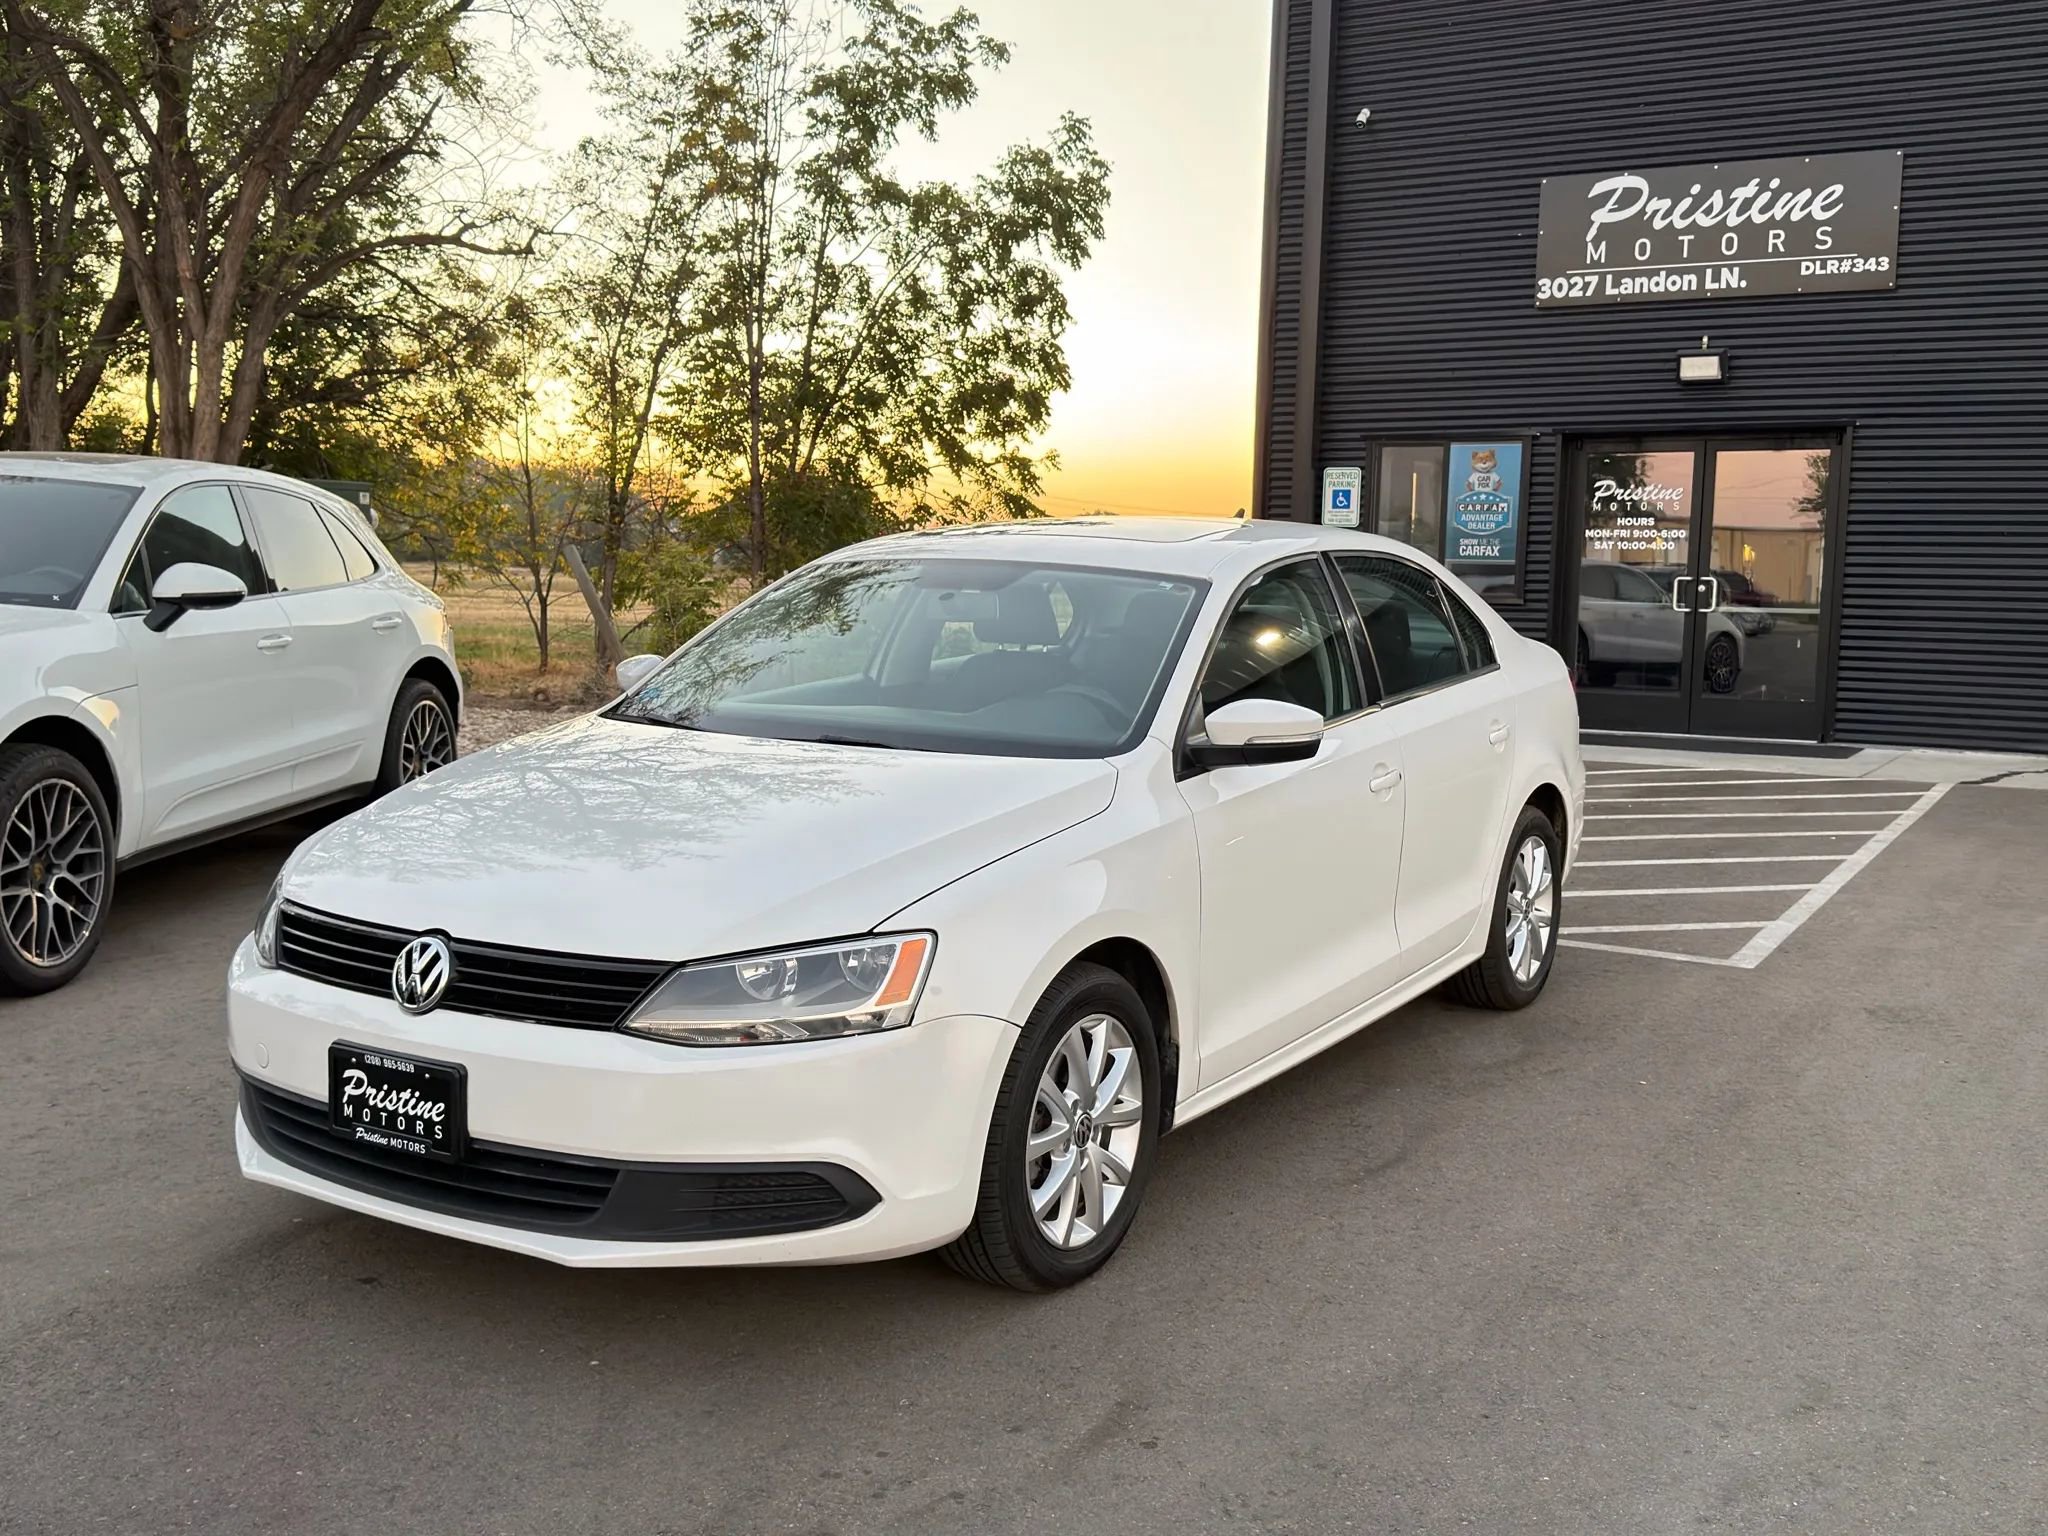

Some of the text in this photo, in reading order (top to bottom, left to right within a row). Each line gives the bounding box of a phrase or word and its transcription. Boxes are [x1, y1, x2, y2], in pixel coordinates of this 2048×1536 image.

[1586, 174, 1845, 242] Pristine
[1585, 226, 1833, 265] MOTORS
[1800, 256, 1890, 277] DLR#343
[1536, 266, 1748, 299] 3027 Landon LN.
[1328, 480, 1356, 488] PARKING
[1593, 479, 1684, 504] Pristine
[1459, 503, 1508, 512] CARFAX
[1593, 502, 1680, 511] MOTORS
[1461, 513, 1503, 521] ADVANTAGE
[1616, 517, 1655, 526] HOURS
[1467, 521, 1496, 530] DEALER
[1584, 529, 1686, 538] MON-FRI 9:00-6:00
[1459, 545, 1500, 557] CARFAX
[1593, 541, 1675, 550] SAT 10:00-4:00
[364, 1054, 381, 1067] (208)
[342, 1068, 445, 1122] Pristine
[343, 1103, 443, 1139] MOTORS
[355, 1127, 426, 1154] Pristine MOTORS
